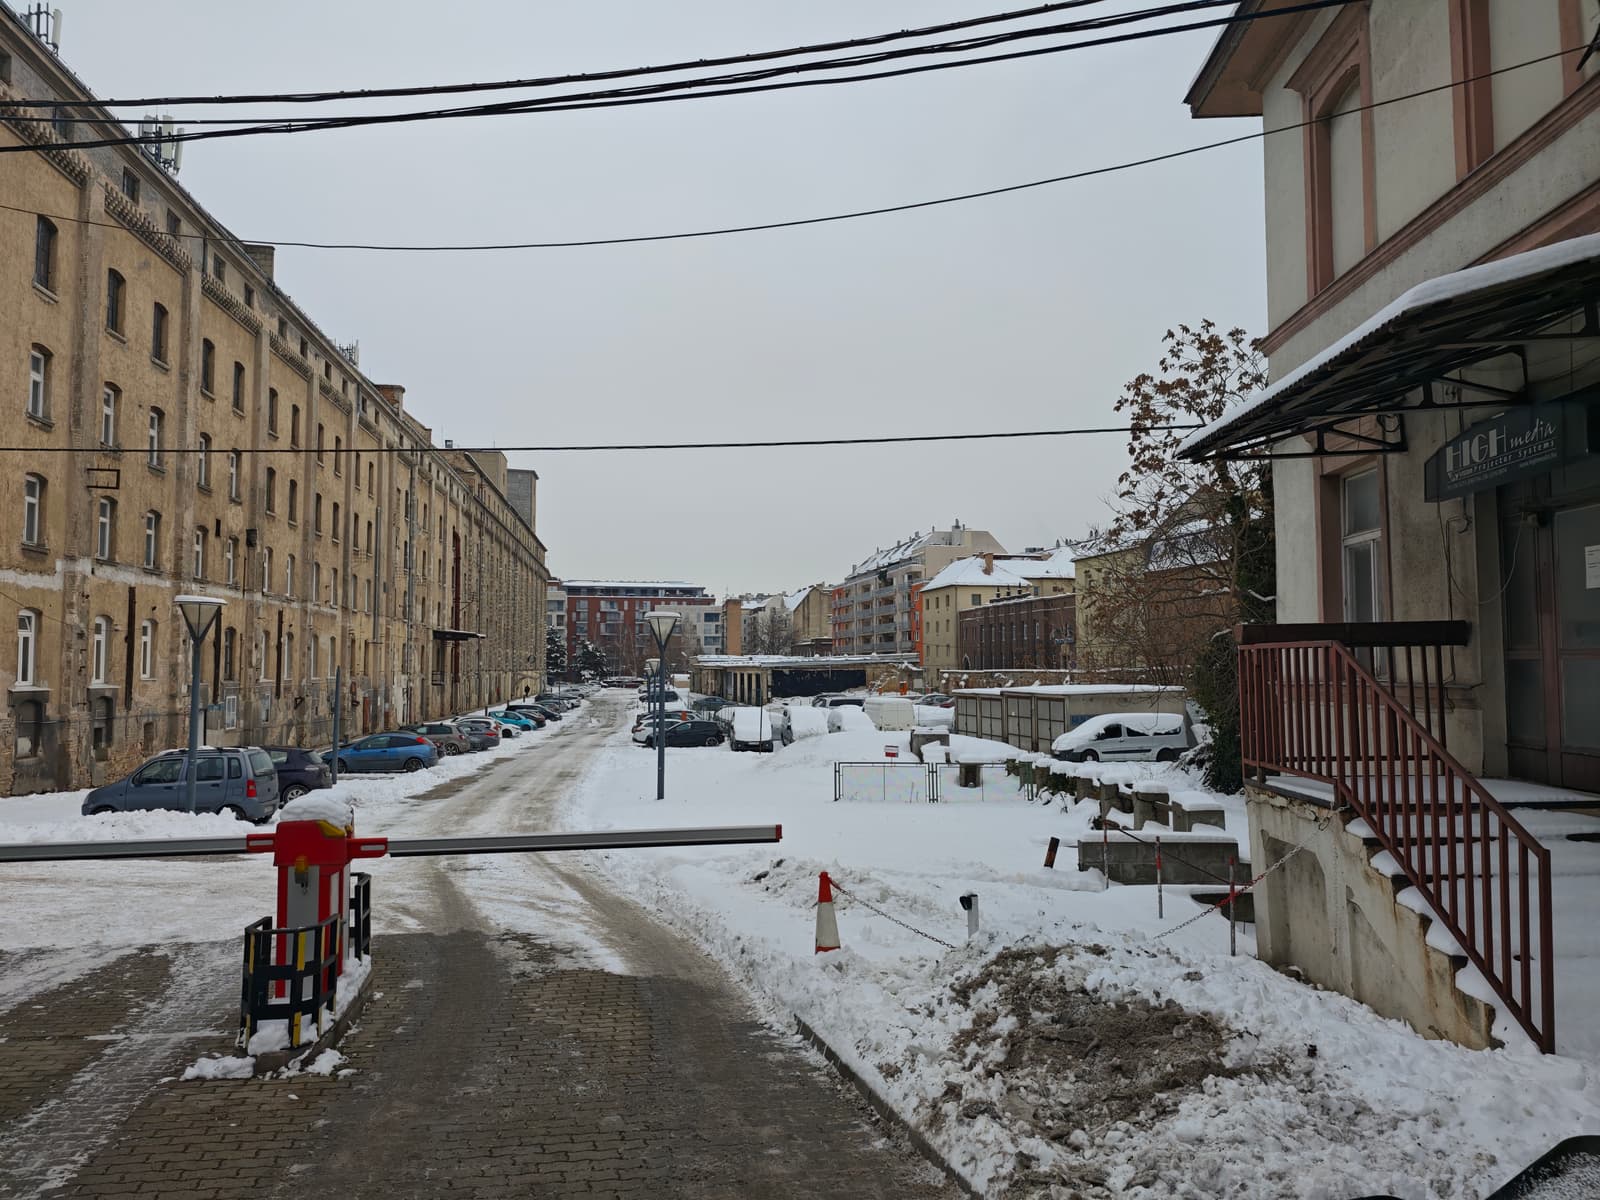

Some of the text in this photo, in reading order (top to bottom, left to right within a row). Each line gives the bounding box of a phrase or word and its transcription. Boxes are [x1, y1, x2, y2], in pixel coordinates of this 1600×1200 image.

[1446, 417, 1556, 473] HIGH media
[1473, 453, 1512, 472] Projector
[1518, 440, 1555, 458] Systems
